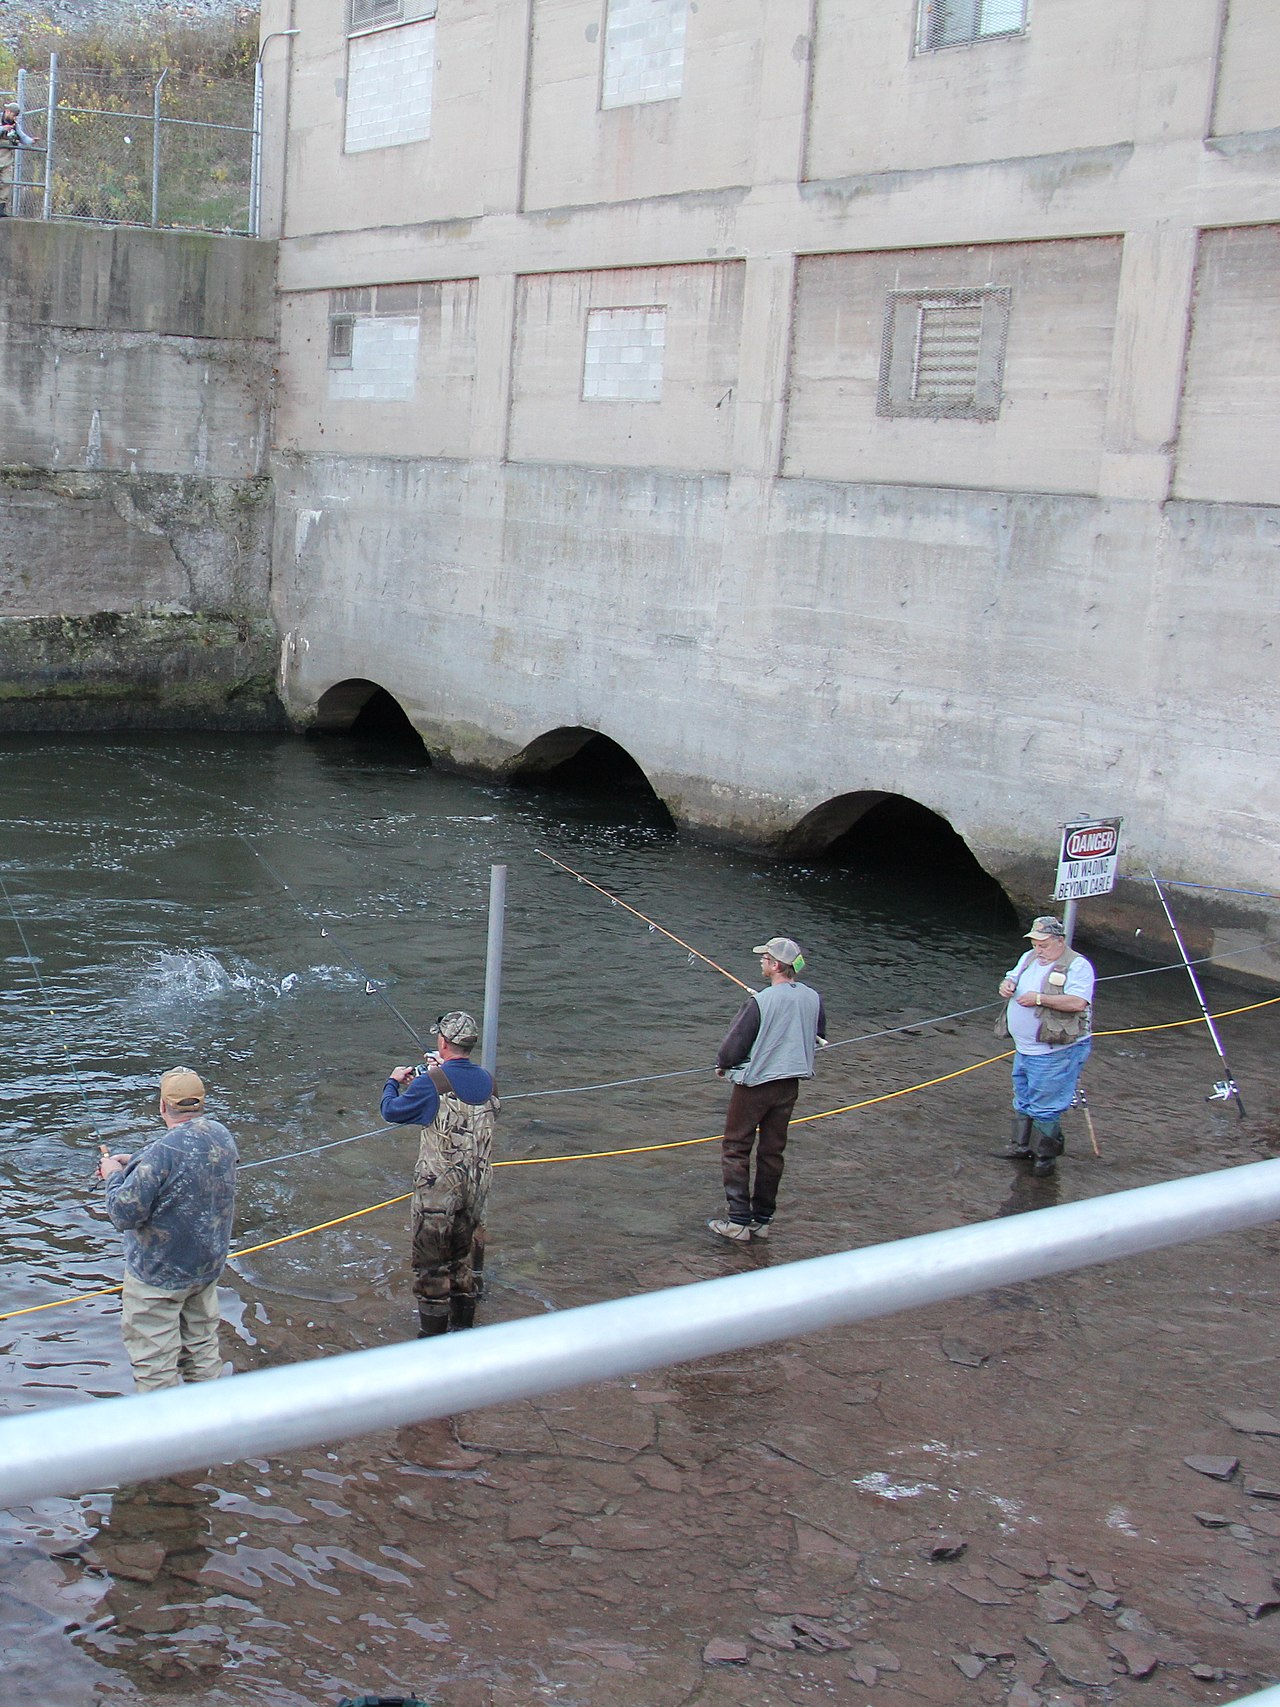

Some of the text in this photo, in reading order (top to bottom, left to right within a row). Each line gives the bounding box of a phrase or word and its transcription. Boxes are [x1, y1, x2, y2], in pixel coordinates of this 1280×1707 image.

[1072, 831, 1113, 854] DANGER
[1067, 858, 1109, 879] NO WADING
[1059, 876, 1111, 898] BEYOND CABLE
